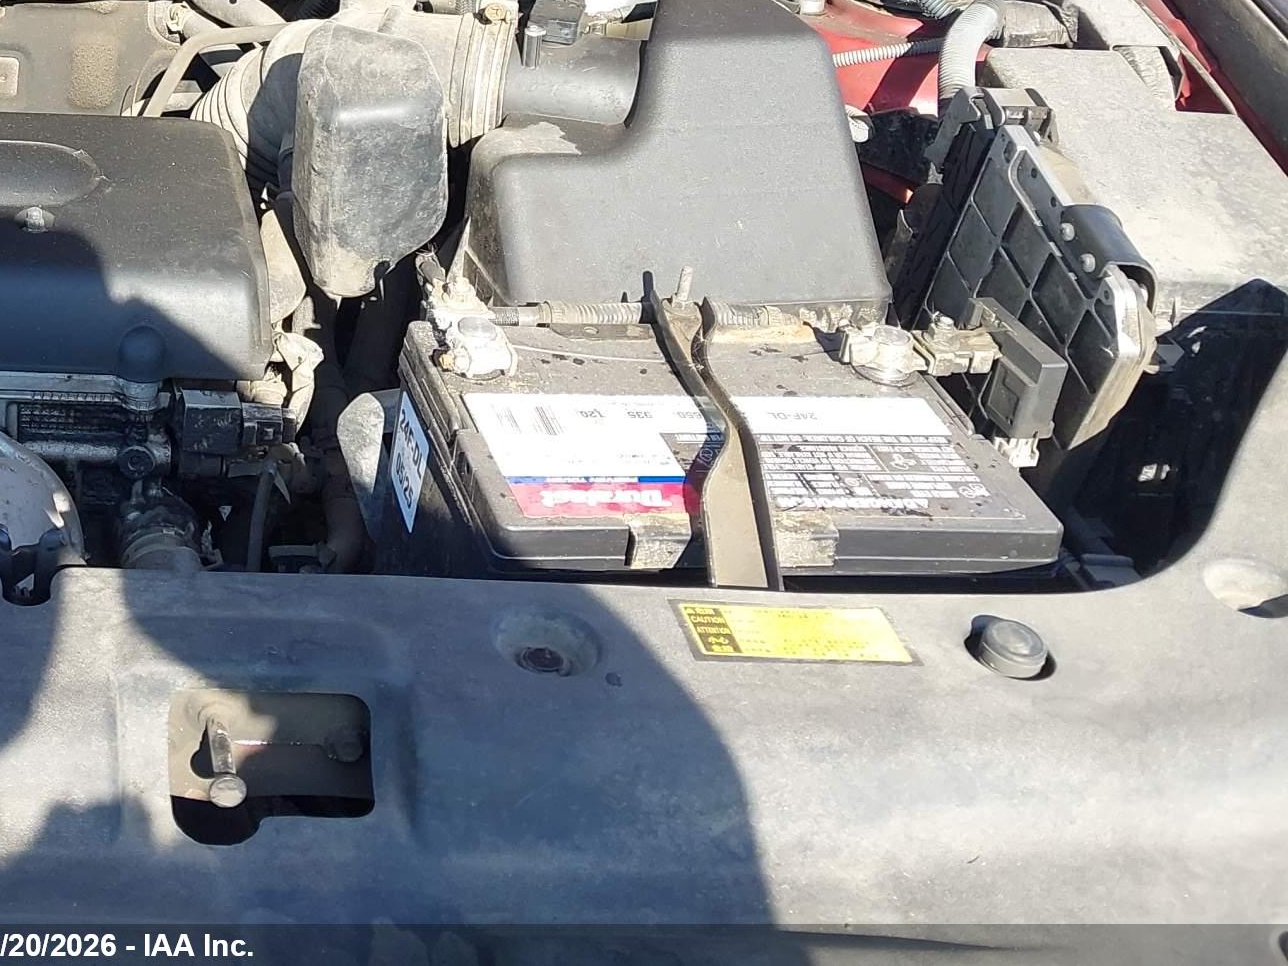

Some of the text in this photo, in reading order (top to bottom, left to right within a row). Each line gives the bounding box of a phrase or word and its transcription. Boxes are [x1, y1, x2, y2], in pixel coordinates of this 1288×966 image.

[399, 408, 423, 480] 24F-DL
[690, 615, 726, 624] CAUTION
[696, 626, 732, 635] ATTENTION
